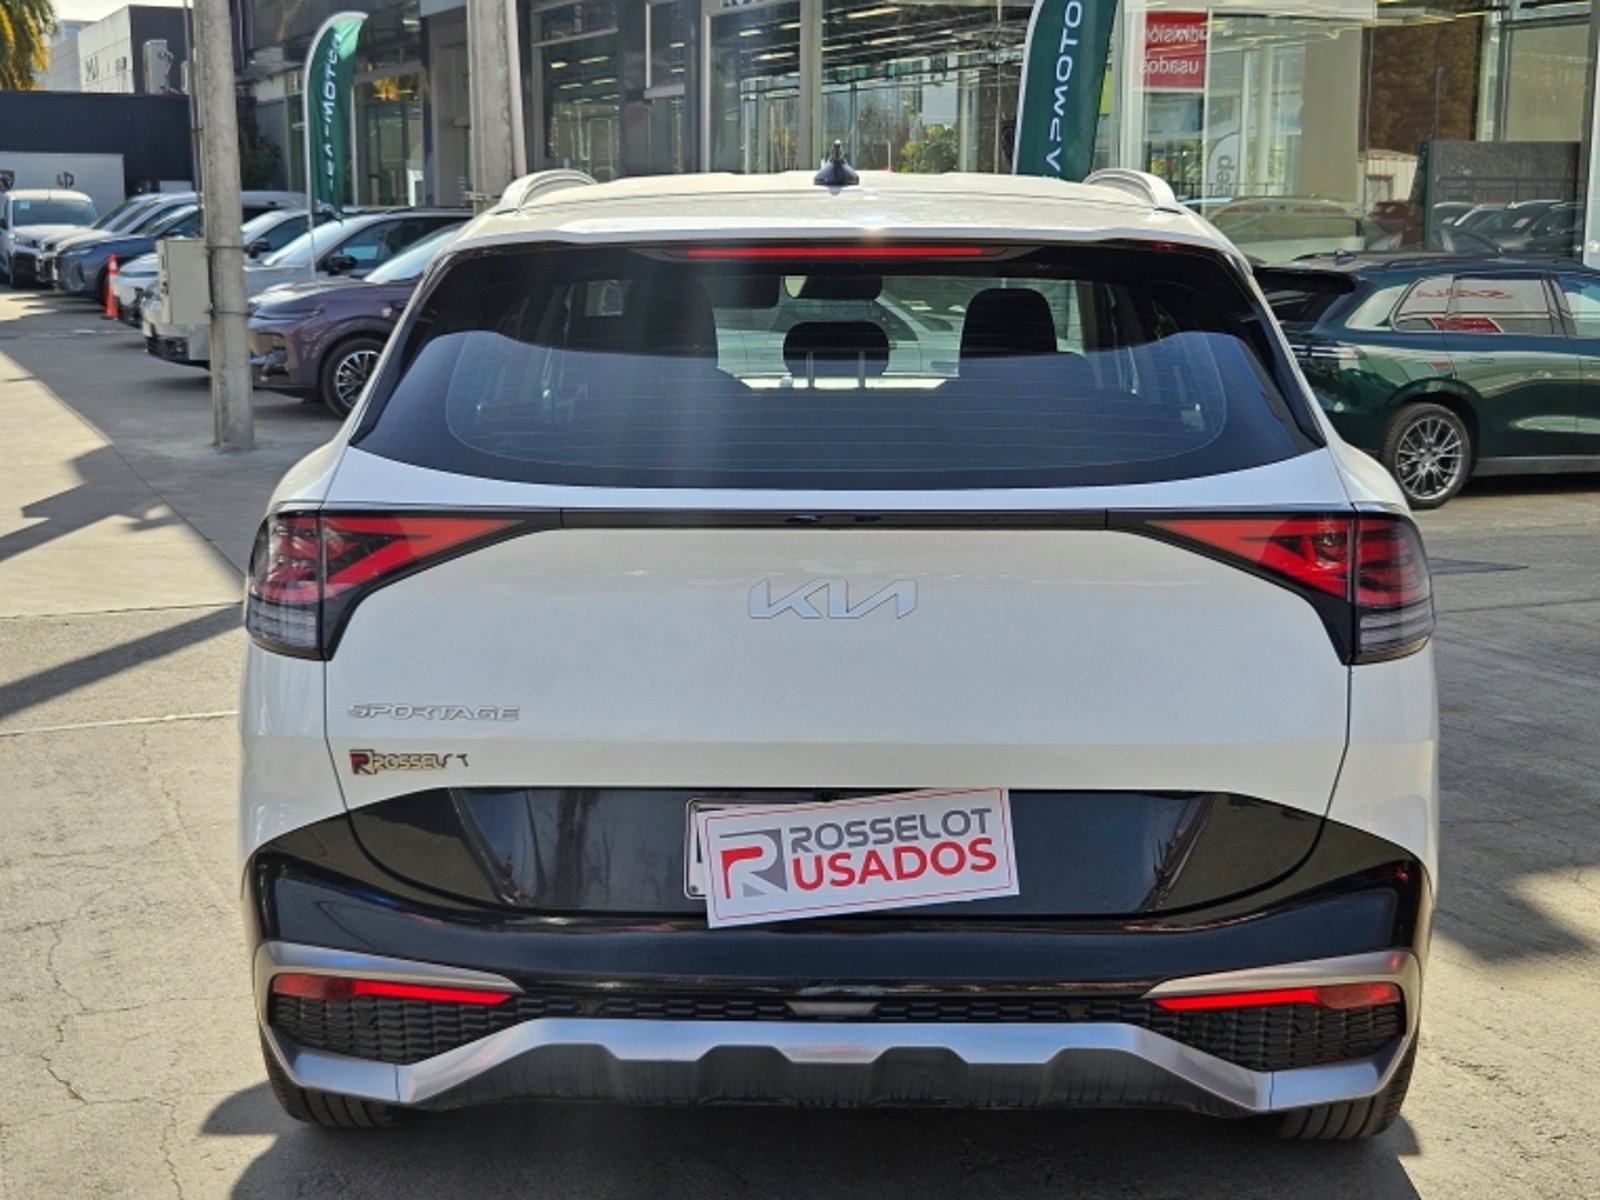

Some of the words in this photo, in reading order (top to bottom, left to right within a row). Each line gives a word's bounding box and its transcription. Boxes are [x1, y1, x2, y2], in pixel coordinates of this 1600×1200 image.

[1045, 0, 1083, 173] APMOTO
[748, 577, 918, 619] KIA
[348, 704, 521, 721] SPORTAGE
[789, 808, 992, 854] ROSSELOT
[793, 838, 997, 891] USADOS
